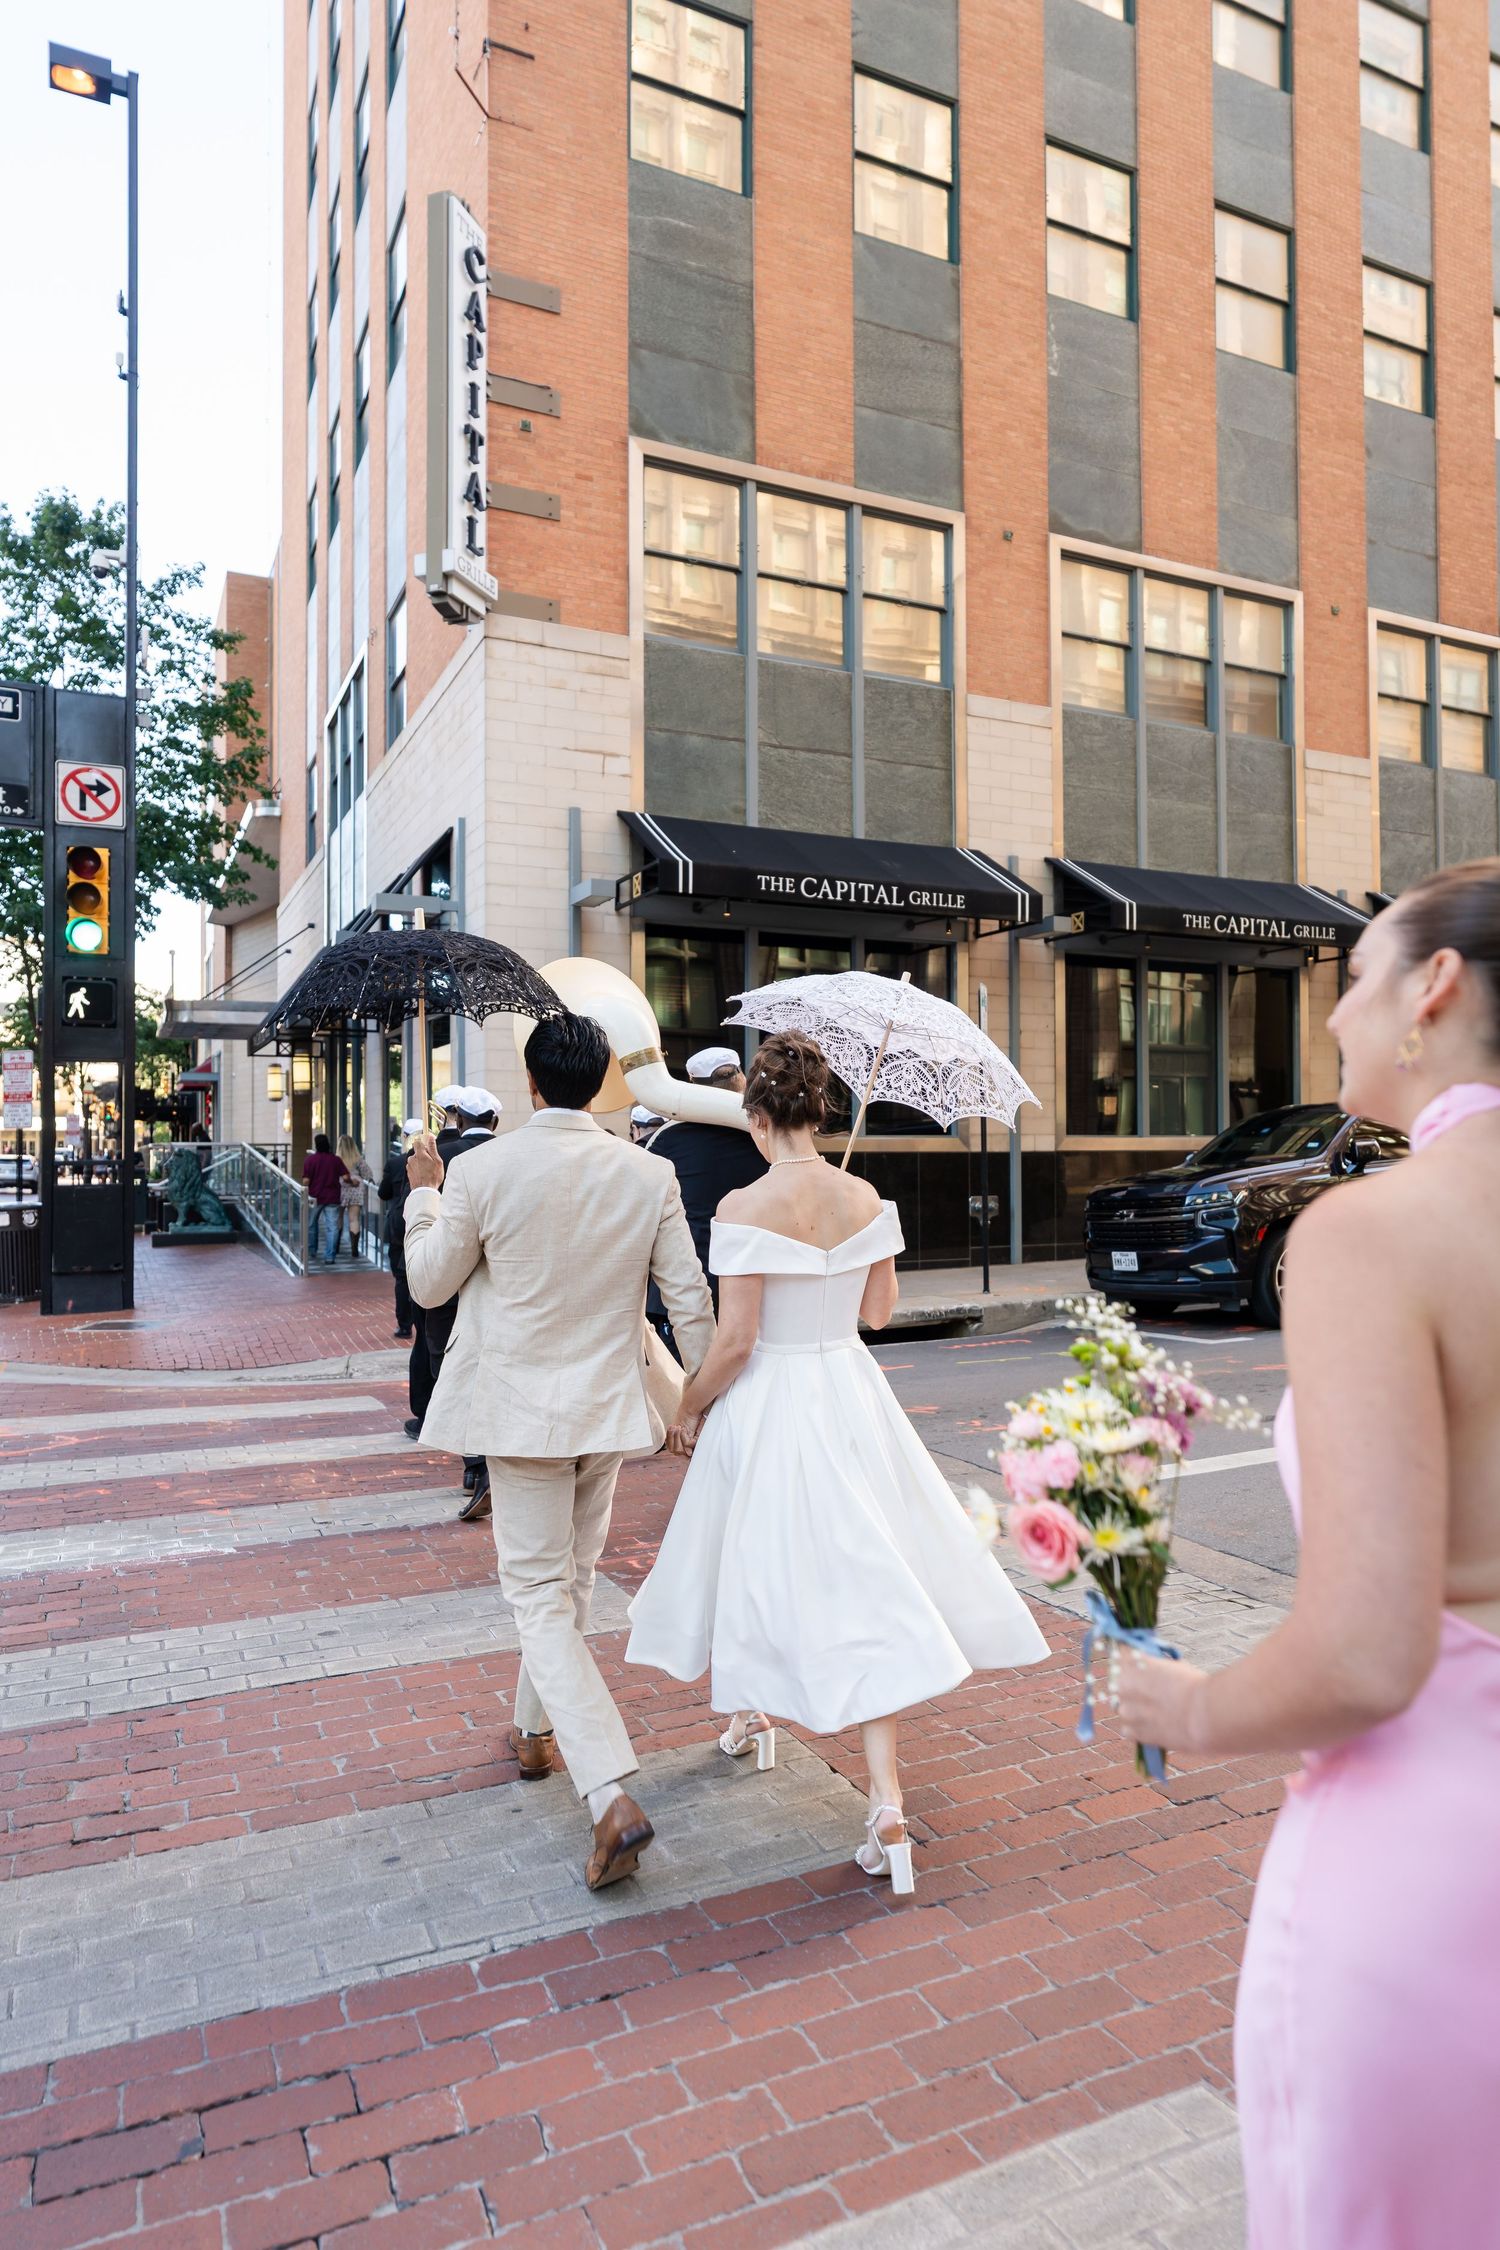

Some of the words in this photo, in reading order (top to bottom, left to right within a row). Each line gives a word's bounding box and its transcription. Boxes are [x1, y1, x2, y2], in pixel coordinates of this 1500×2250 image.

[464, 246, 487, 557] CAPITAL
[457, 556, 496, 595] GRILLE
[757, 875, 796, 893] THE
[800, 877, 904, 906] CAPITAL
[909, 891, 966, 908] GRILLE
[1183, 914, 1211, 929] THE
[1214, 915, 1291, 939] CAPITAL
[1294, 925, 1336, 940] GRILLE
